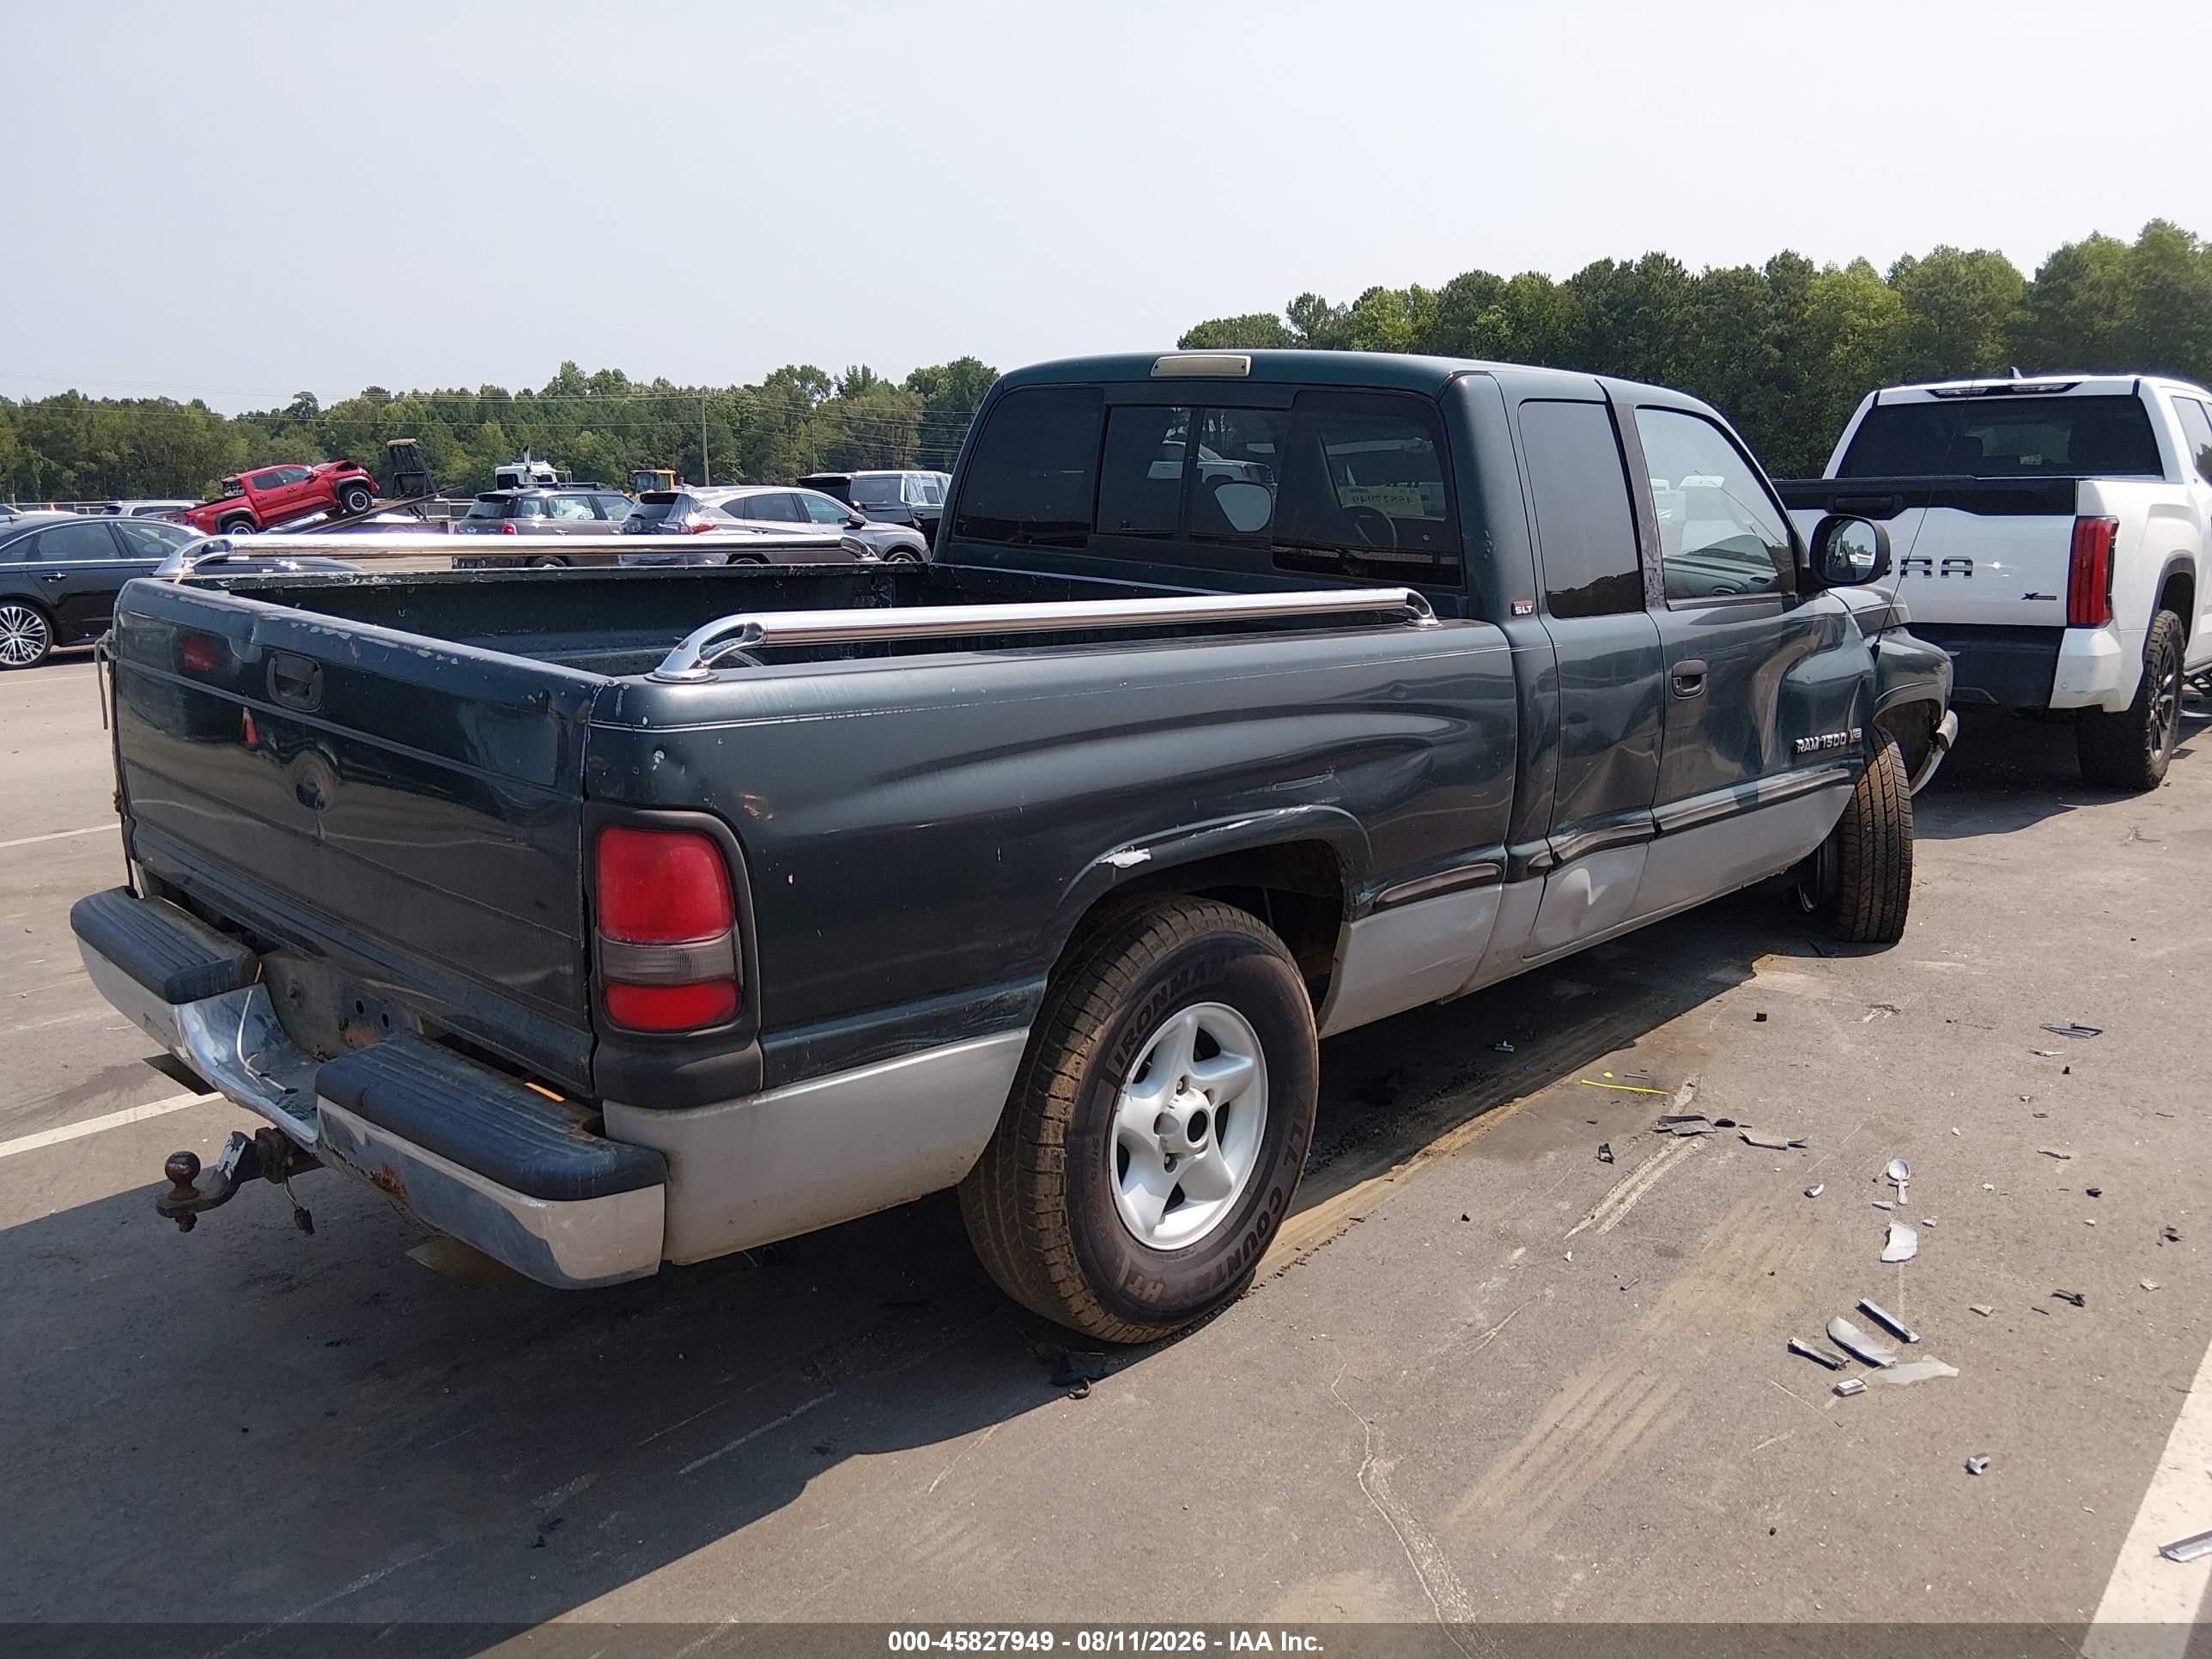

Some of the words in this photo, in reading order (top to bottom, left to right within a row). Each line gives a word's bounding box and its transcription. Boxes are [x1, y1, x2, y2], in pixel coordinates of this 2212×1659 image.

[1515, 605, 1533, 614] SLT
[1795, 736, 1819, 753] RAM
[1819, 732, 1847, 749] 1500
[1113, 954, 1233, 1070] IRONMAN
